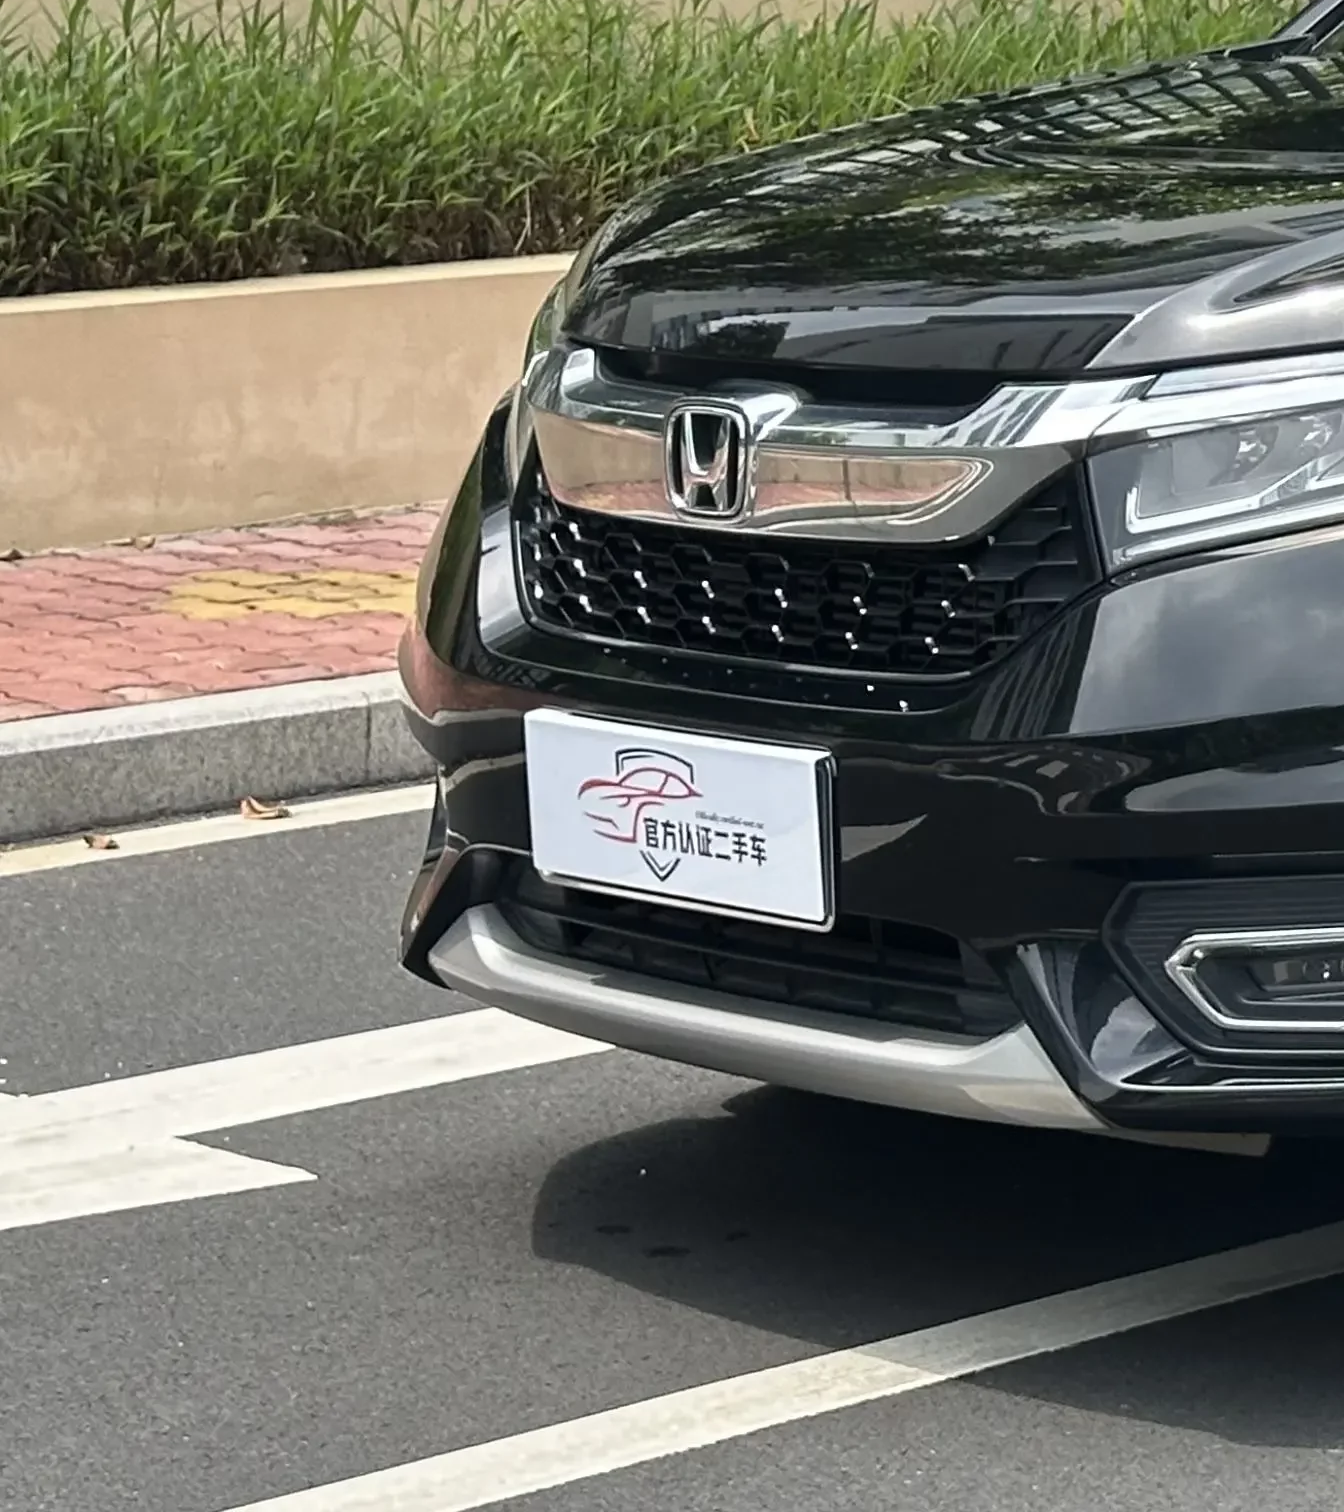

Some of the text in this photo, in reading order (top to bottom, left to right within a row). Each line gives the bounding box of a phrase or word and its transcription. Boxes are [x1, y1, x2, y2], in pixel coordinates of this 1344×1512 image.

[643, 817, 767, 866] 官方认证二手车
